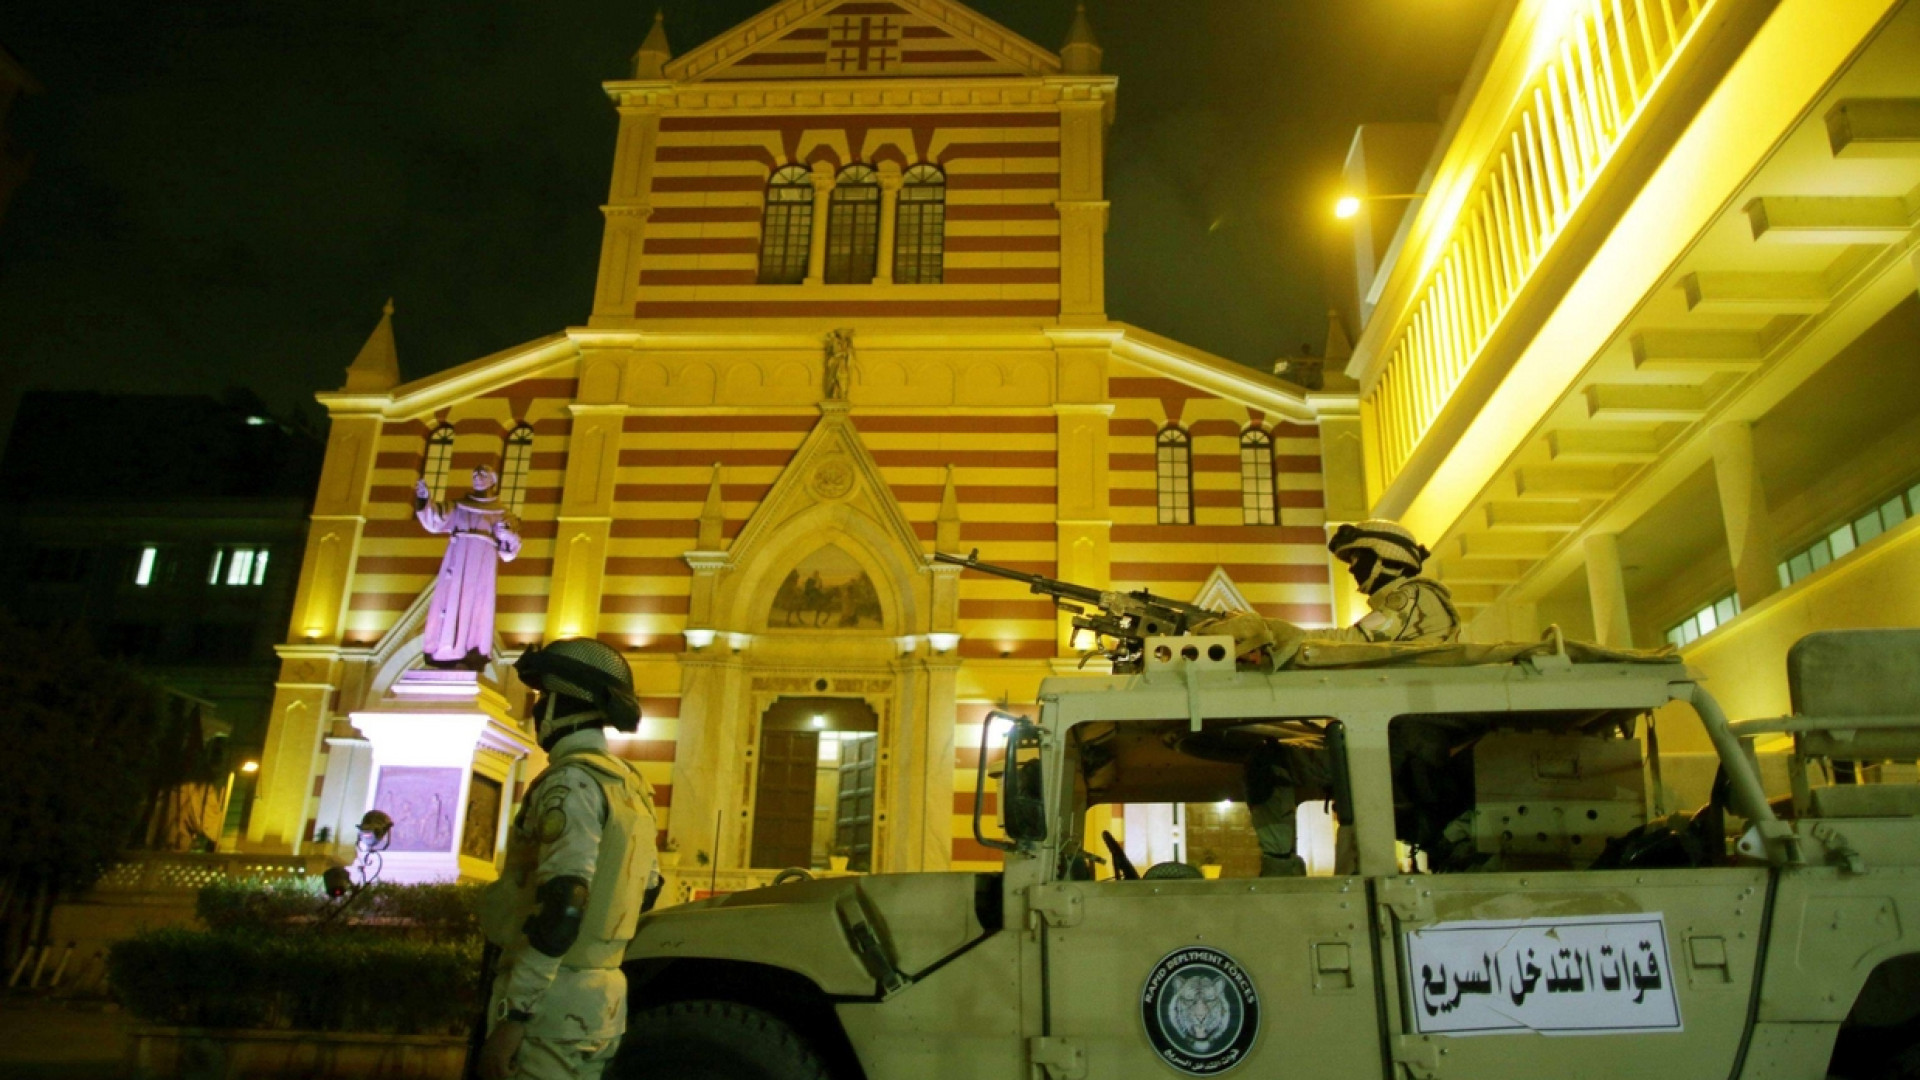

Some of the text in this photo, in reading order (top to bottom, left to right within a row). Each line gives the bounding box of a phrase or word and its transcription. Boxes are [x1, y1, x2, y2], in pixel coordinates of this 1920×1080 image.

[1145, 968, 1167, 1003] RAPID
[1223, 961, 1255, 1004] FORCES
[1421, 940, 1662, 1016] قوات التدخل السريع
